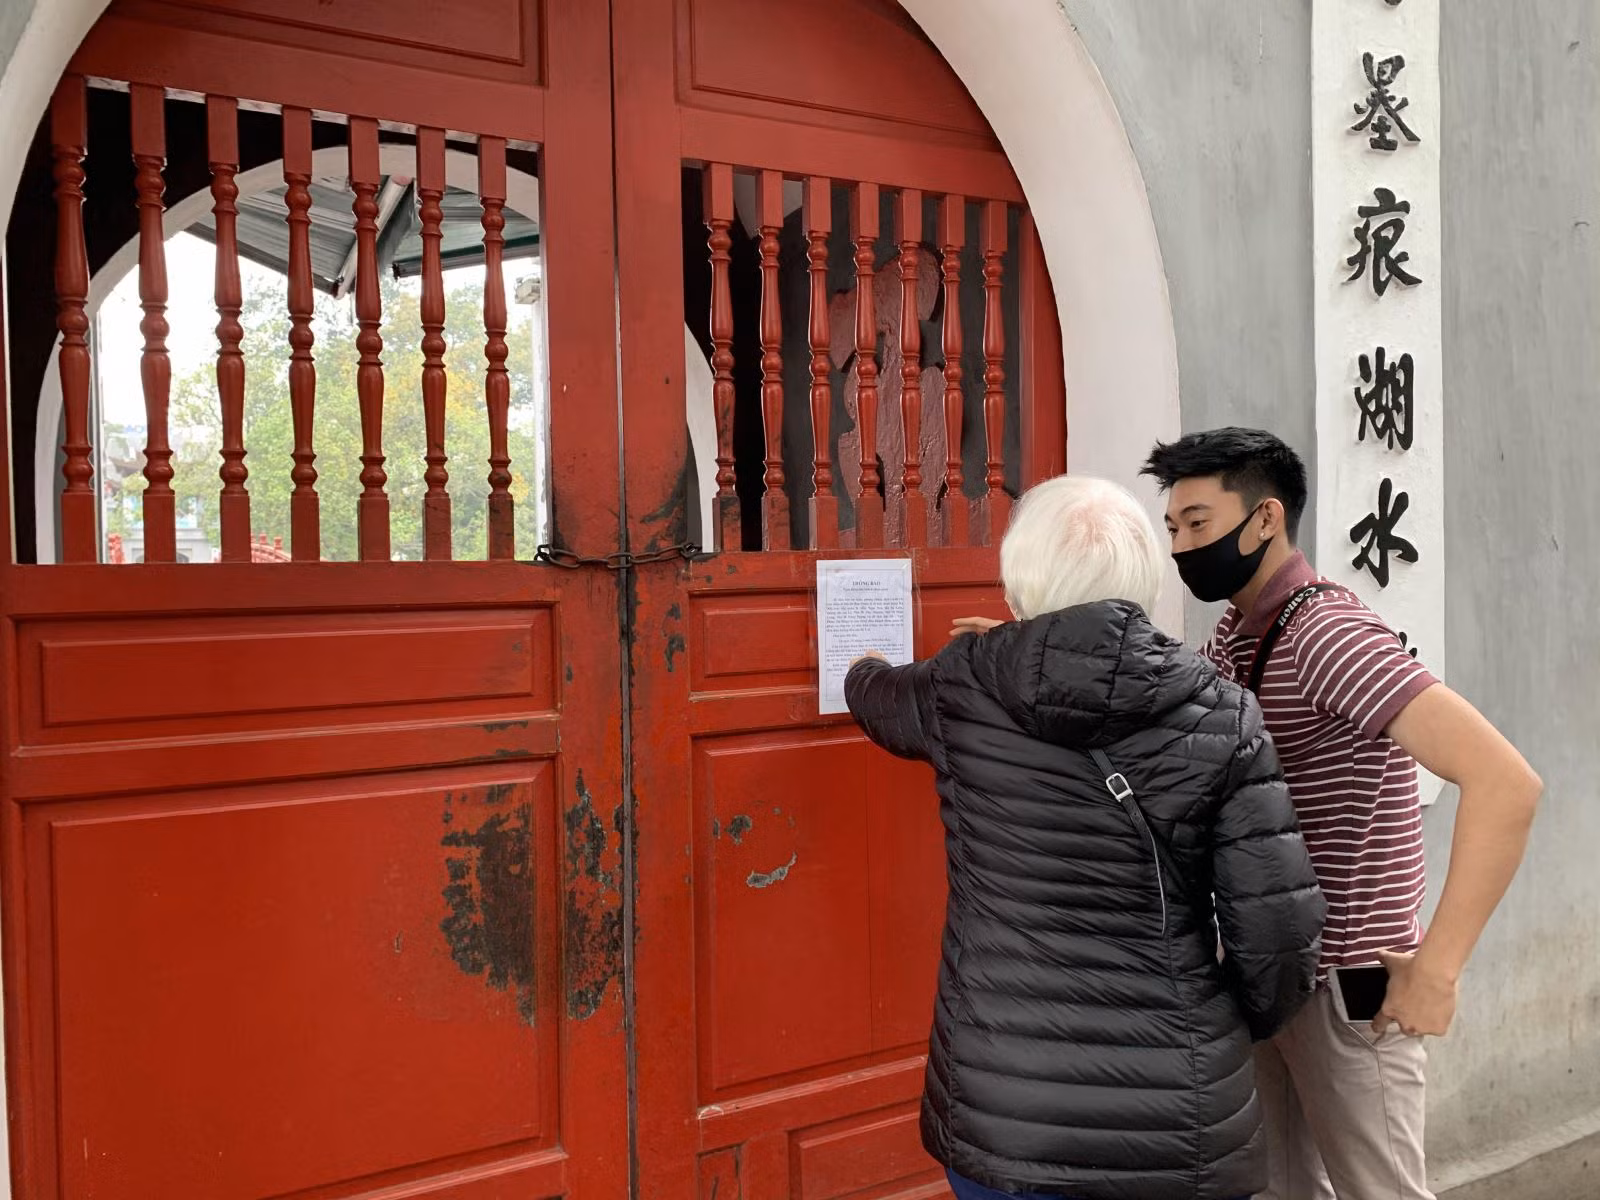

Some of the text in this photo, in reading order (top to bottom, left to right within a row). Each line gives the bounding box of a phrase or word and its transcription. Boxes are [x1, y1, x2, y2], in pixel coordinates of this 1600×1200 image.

[1346, 0, 1422, 658] 墨痕湖水
[1277, 586, 1317, 627] Canon
